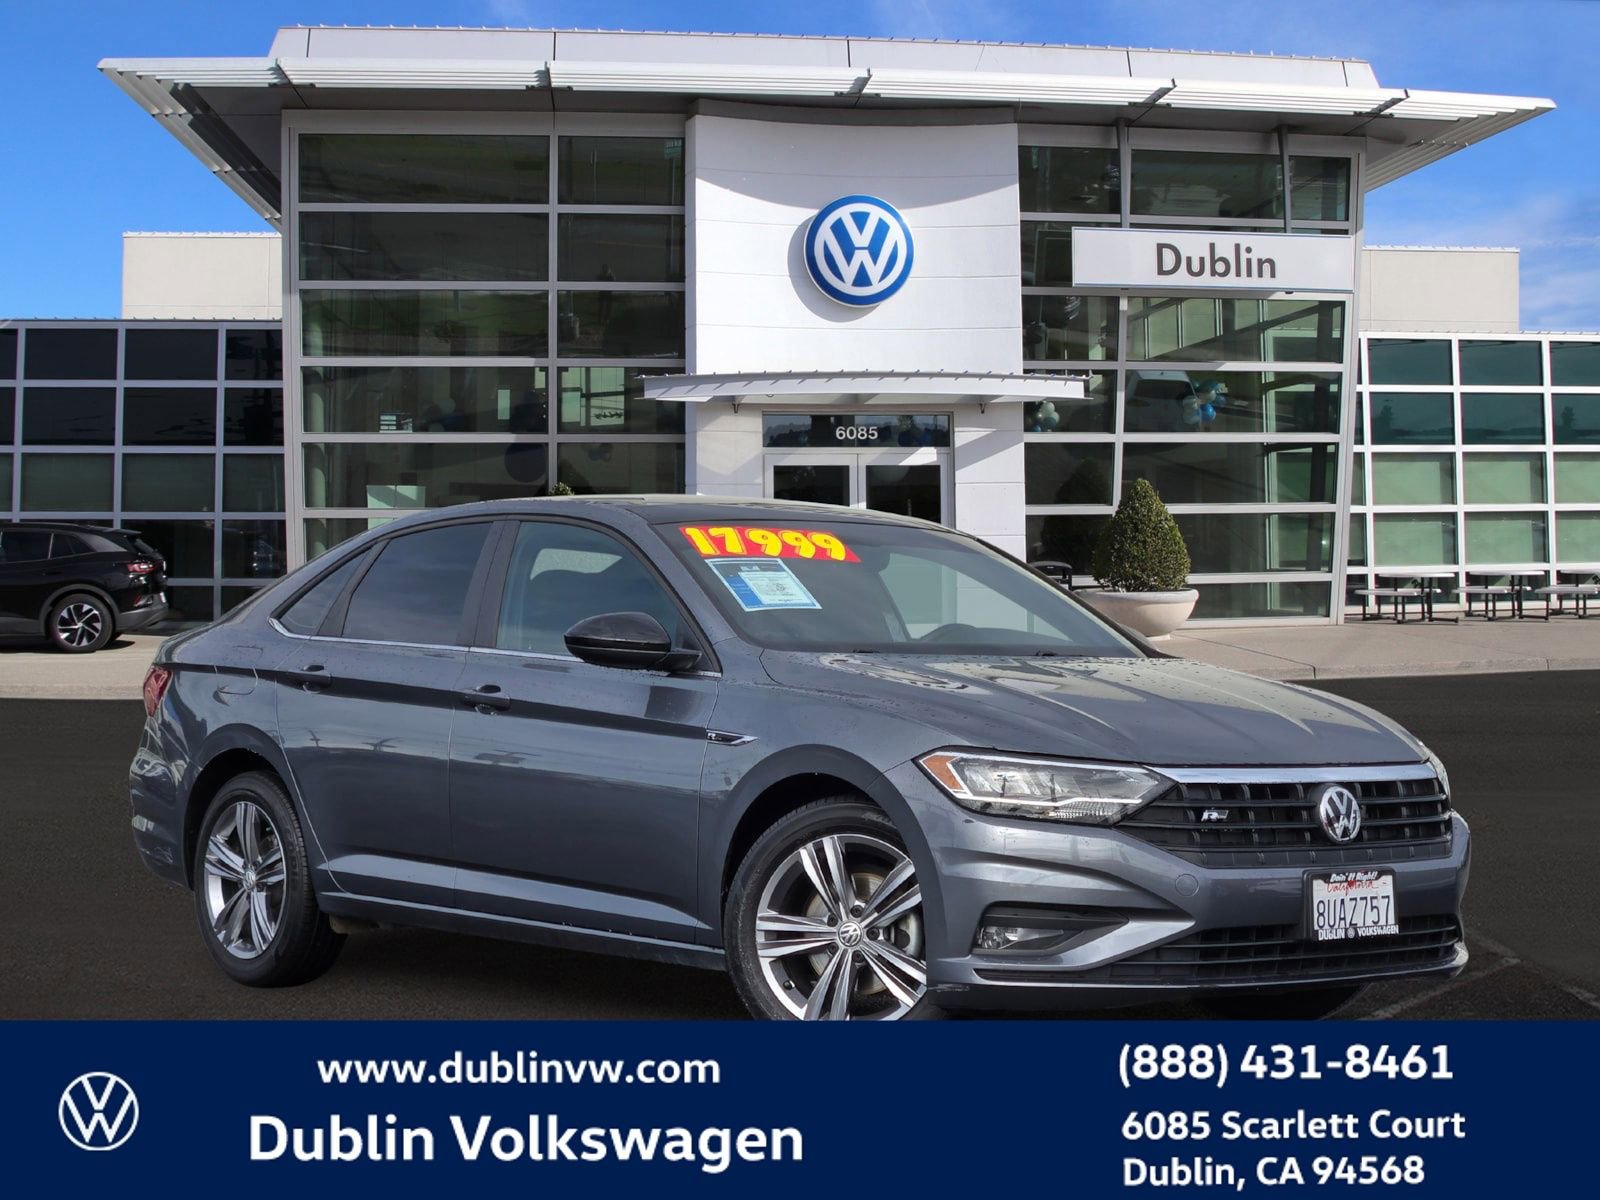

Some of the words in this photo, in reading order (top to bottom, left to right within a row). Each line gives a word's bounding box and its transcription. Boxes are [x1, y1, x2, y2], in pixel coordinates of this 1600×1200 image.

[813, 202, 908, 297] VW
[1156, 242, 1277, 278] Dublin
[835, 426, 879, 440] 6085
[685, 527, 847, 561] 17999
[1320, 786, 1361, 842] VW
[1316, 895, 1391, 929] 8UAZ757
[1318, 928, 1346, 940] DUBLIN
[1357, 925, 1399, 937] VOLKSWAGEN
